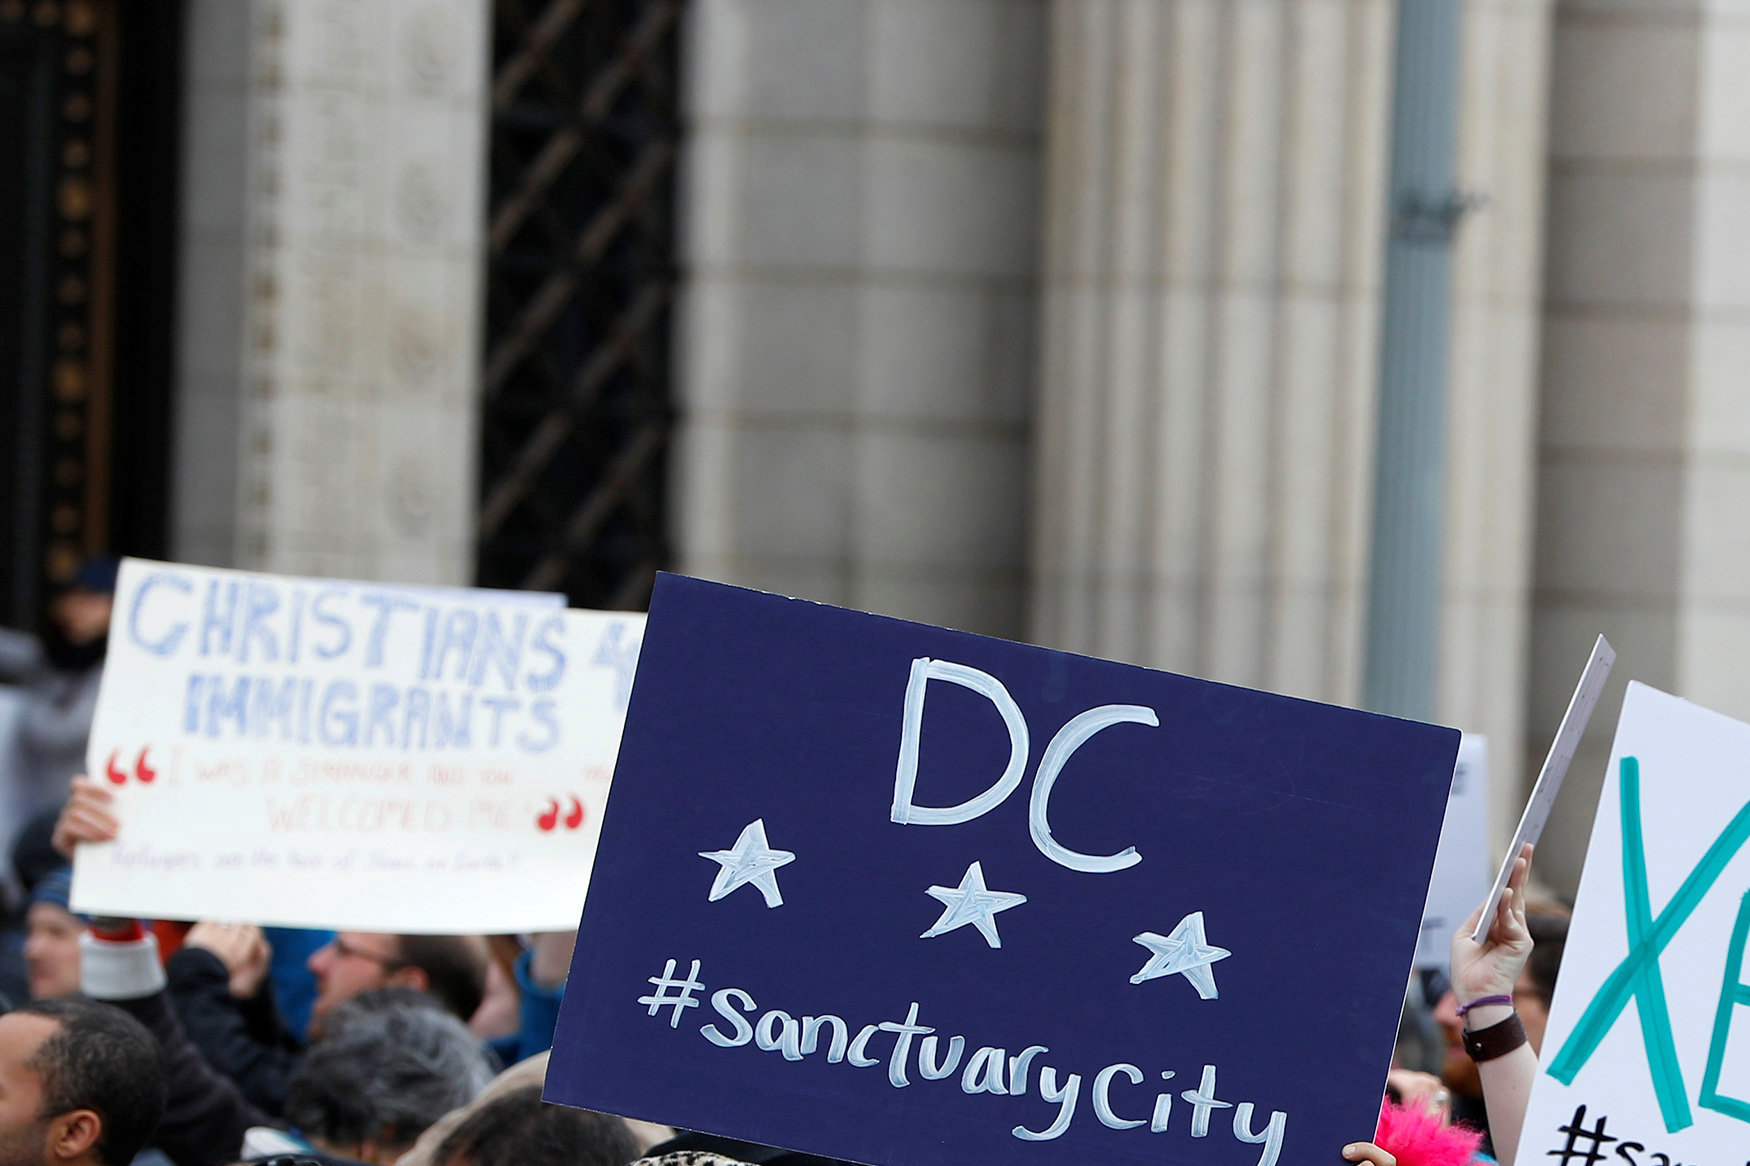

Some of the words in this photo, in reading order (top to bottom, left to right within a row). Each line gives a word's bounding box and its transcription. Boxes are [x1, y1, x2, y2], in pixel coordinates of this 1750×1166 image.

[128, 571, 567, 694] CHRISTIANS
[183, 674, 560, 754] IMMIGRANTS
[890, 656, 1160, 873] DC
